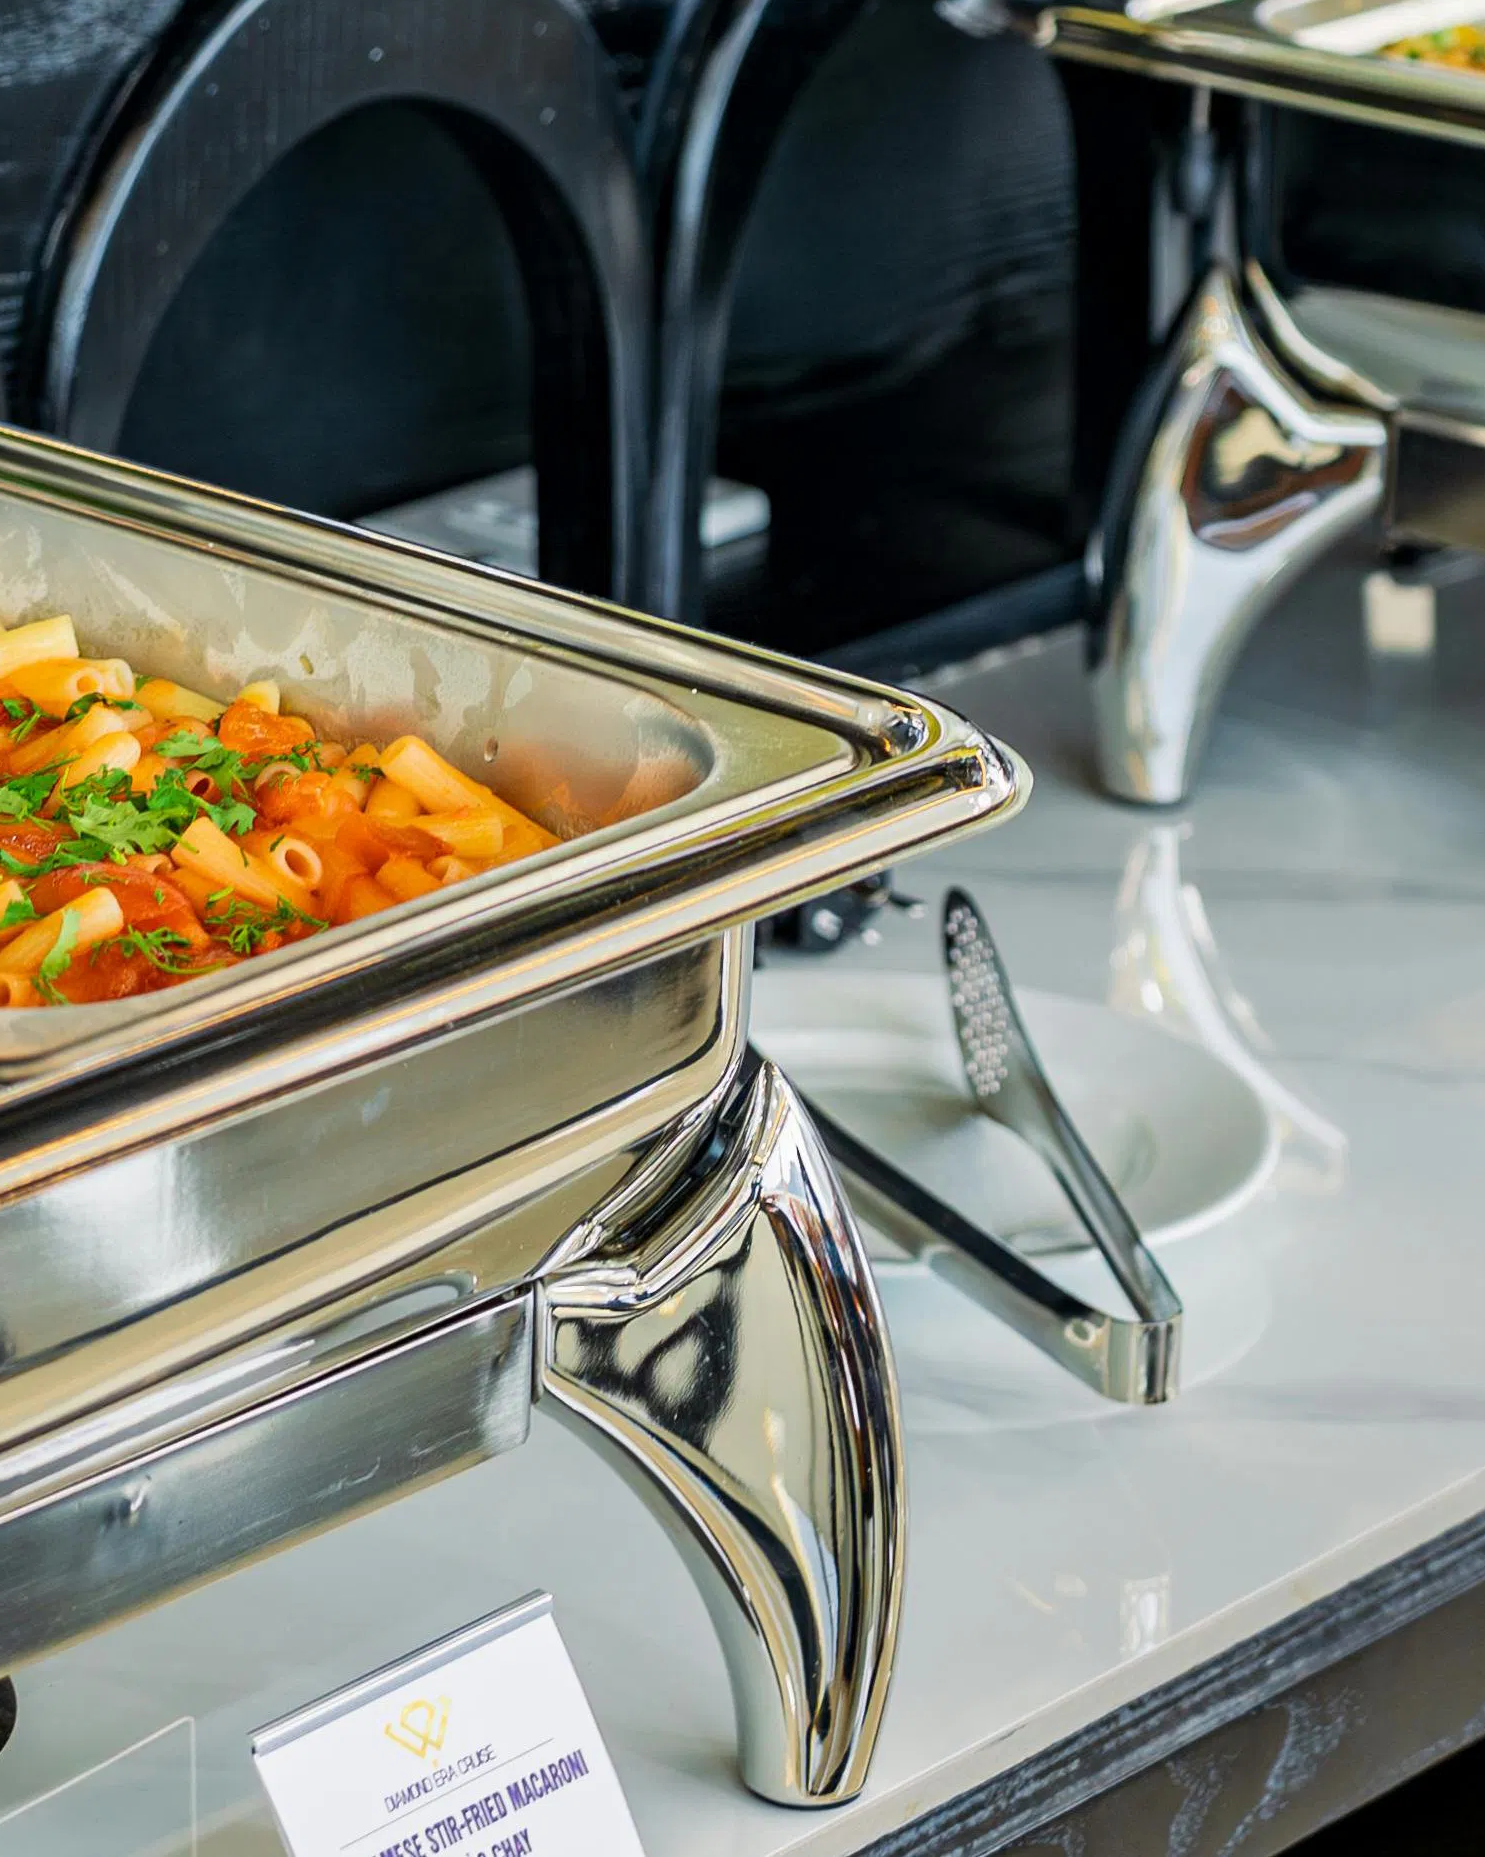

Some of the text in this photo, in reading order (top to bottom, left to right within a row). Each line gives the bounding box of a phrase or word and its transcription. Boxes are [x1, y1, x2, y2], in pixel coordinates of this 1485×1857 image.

[384, 1744, 497, 1813] DIAMOND ERA CRUISE
[425, 1791, 507, 1853] STIR-FRIED
[506, 1749, 589, 1811] MACARONI
